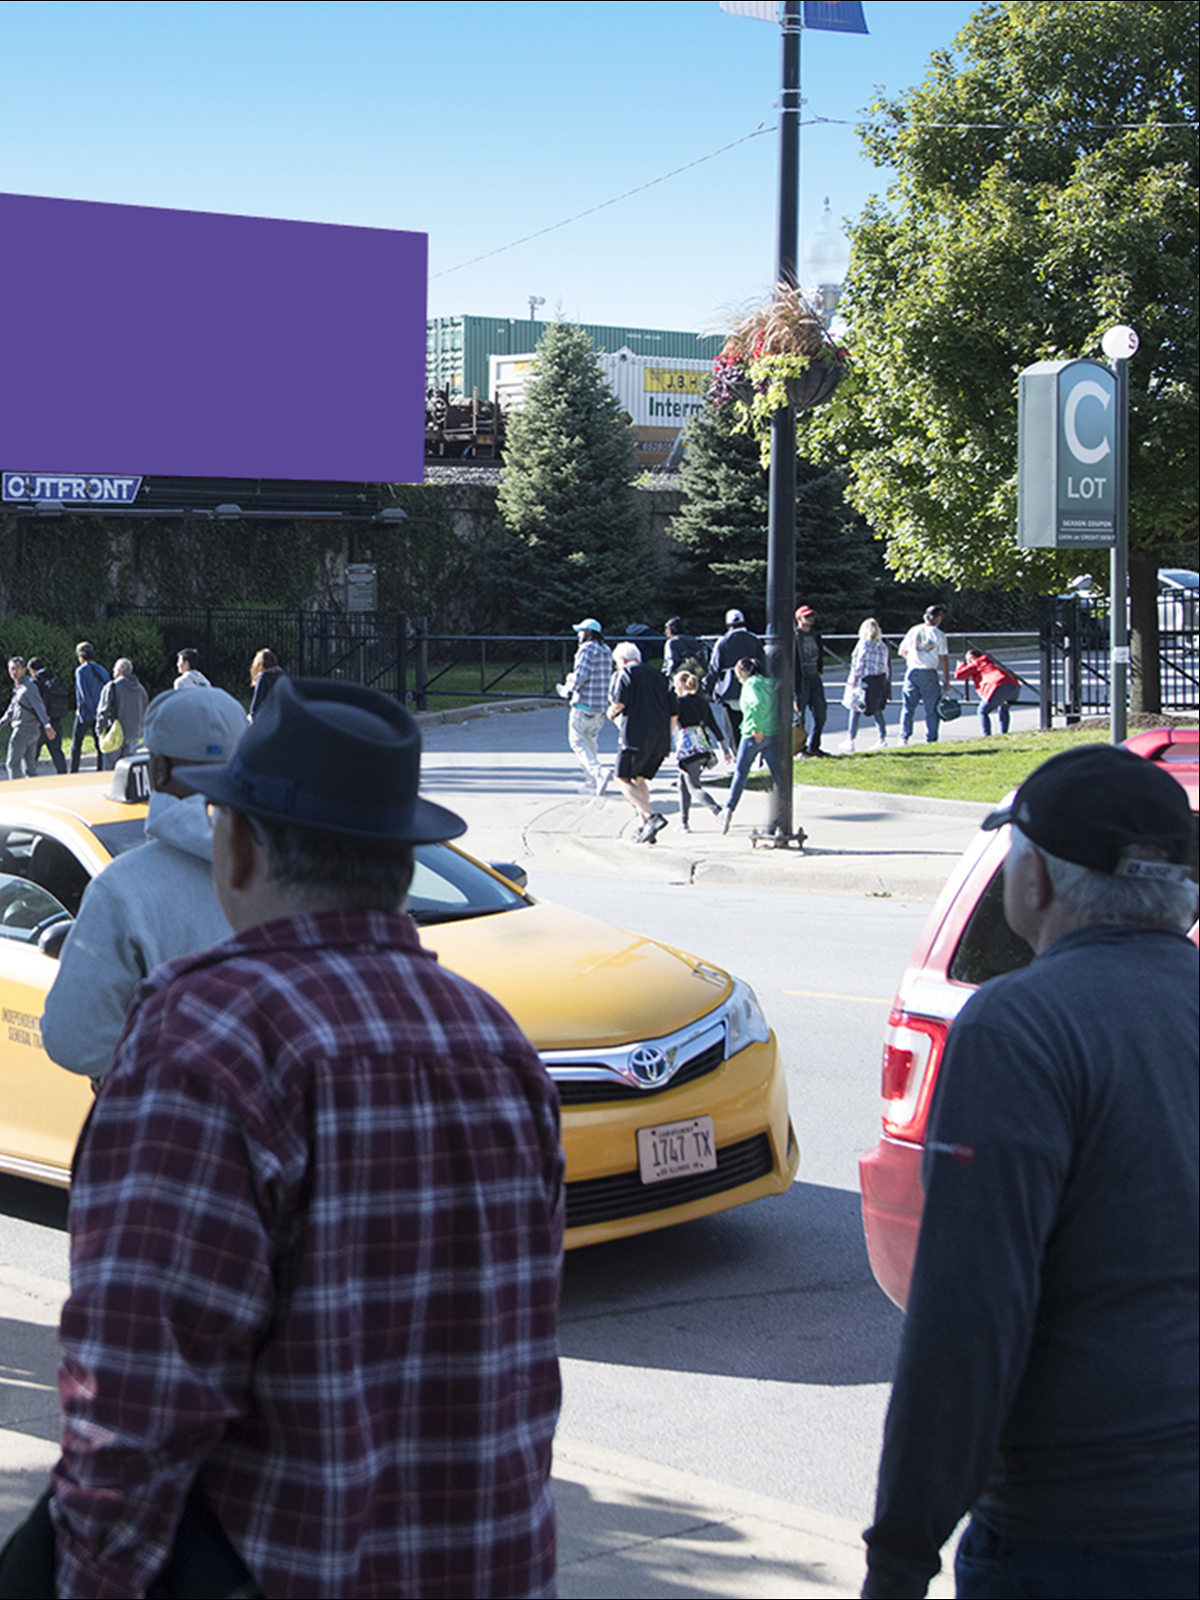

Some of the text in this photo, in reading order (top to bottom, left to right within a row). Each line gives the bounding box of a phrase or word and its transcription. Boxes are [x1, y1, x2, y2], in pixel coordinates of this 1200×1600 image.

[648, 396, 705, 418] Interm
[1064, 380, 1111, 464] C
[7, 476, 134, 500] OUTFRONT
[1067, 476, 1107, 499] LOT
[132, 764, 151, 797] TA
[652, 1129, 712, 1168] 1747 TX
